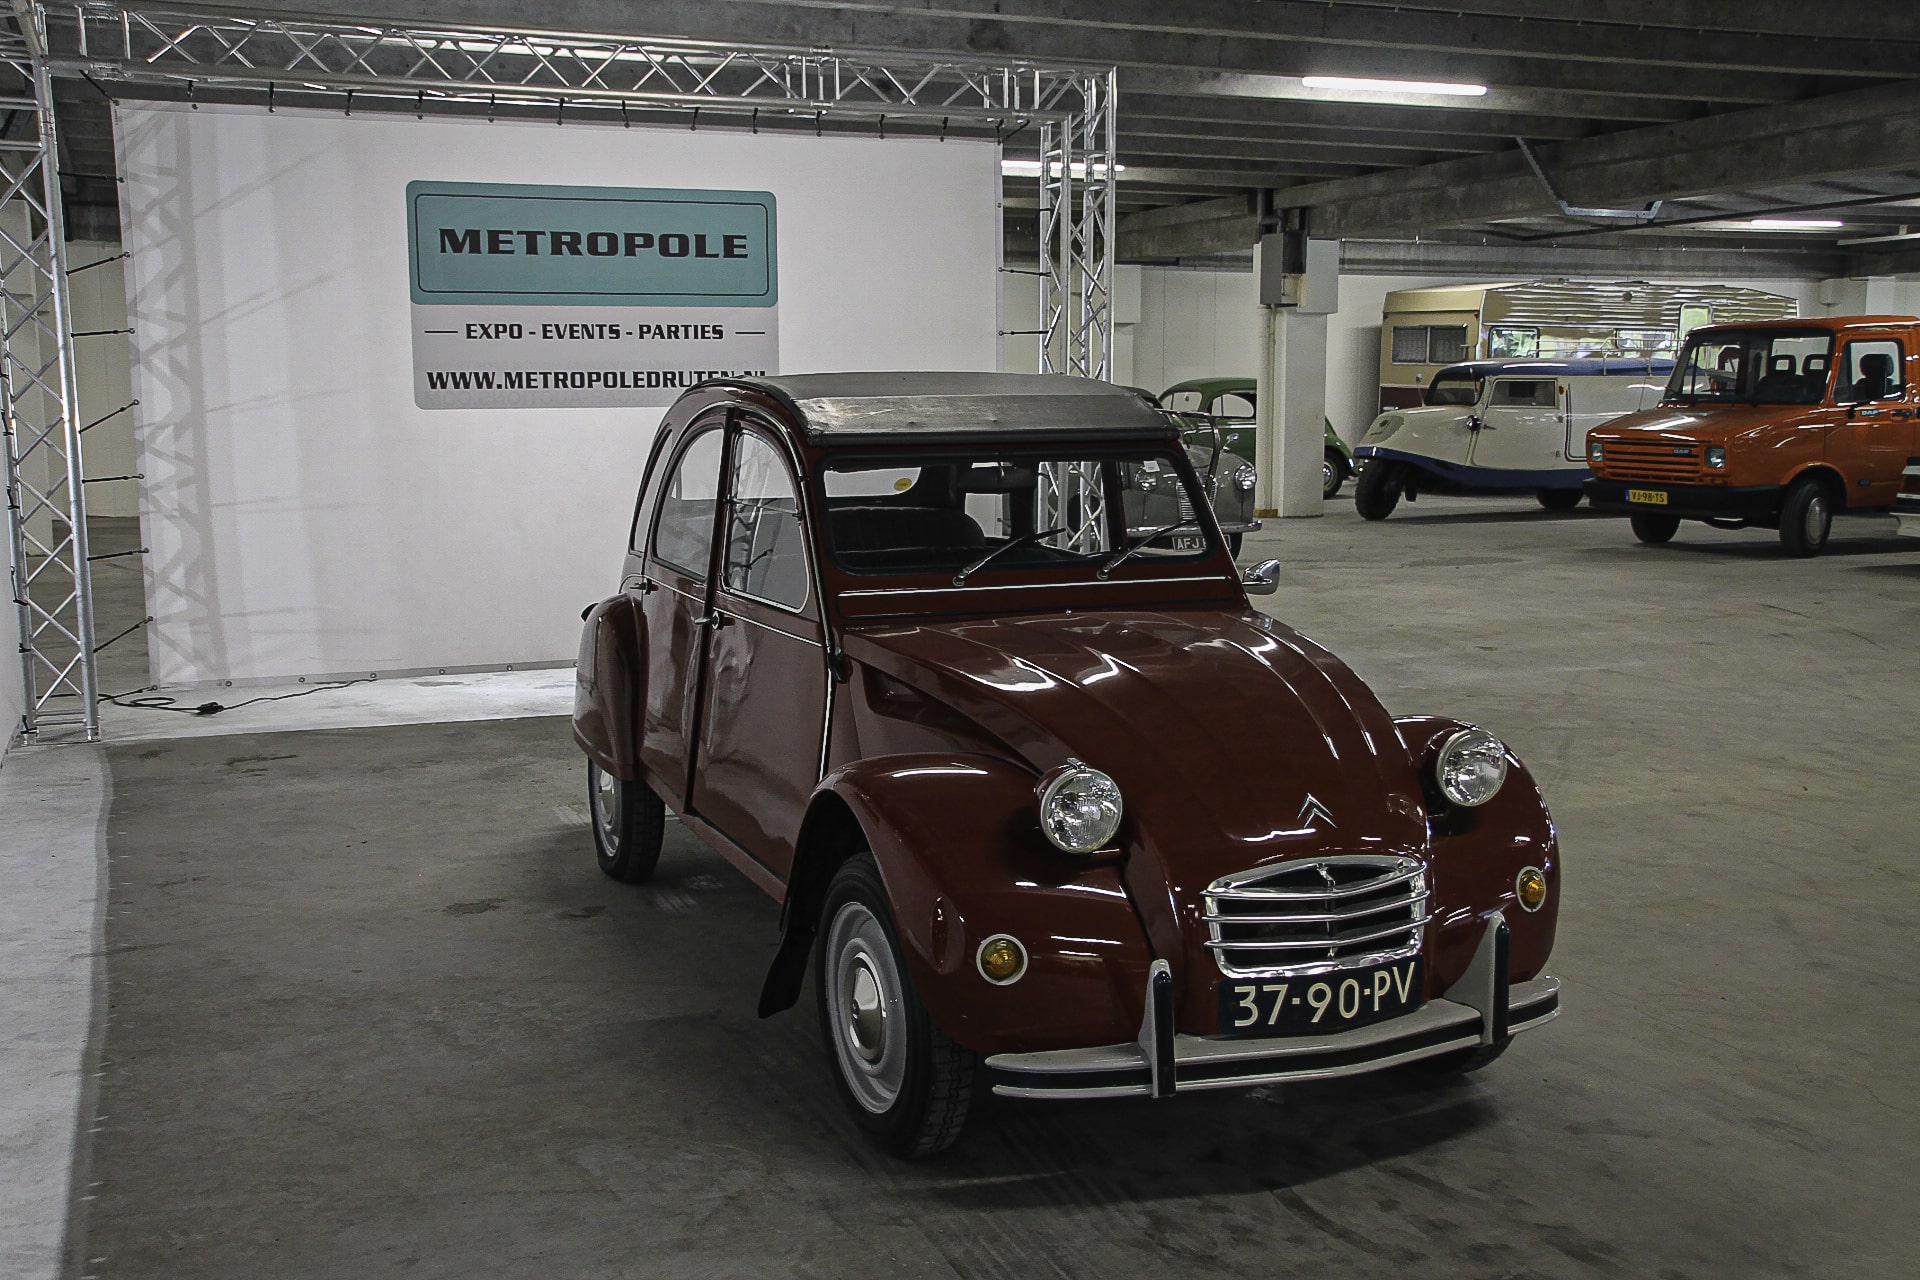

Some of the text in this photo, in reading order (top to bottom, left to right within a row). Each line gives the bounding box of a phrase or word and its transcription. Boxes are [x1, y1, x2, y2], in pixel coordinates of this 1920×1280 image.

[438, 228, 748, 259] METROPOLE
[465, 323, 523, 340] EXPO
[541, 323, 621, 341] EVENTS
[638, 323, 724, 341] PARTIES
[427, 371, 765, 390] WWW.METROPOLEDRUT
[1234, 961, 1416, 1027] 37-90-PV
